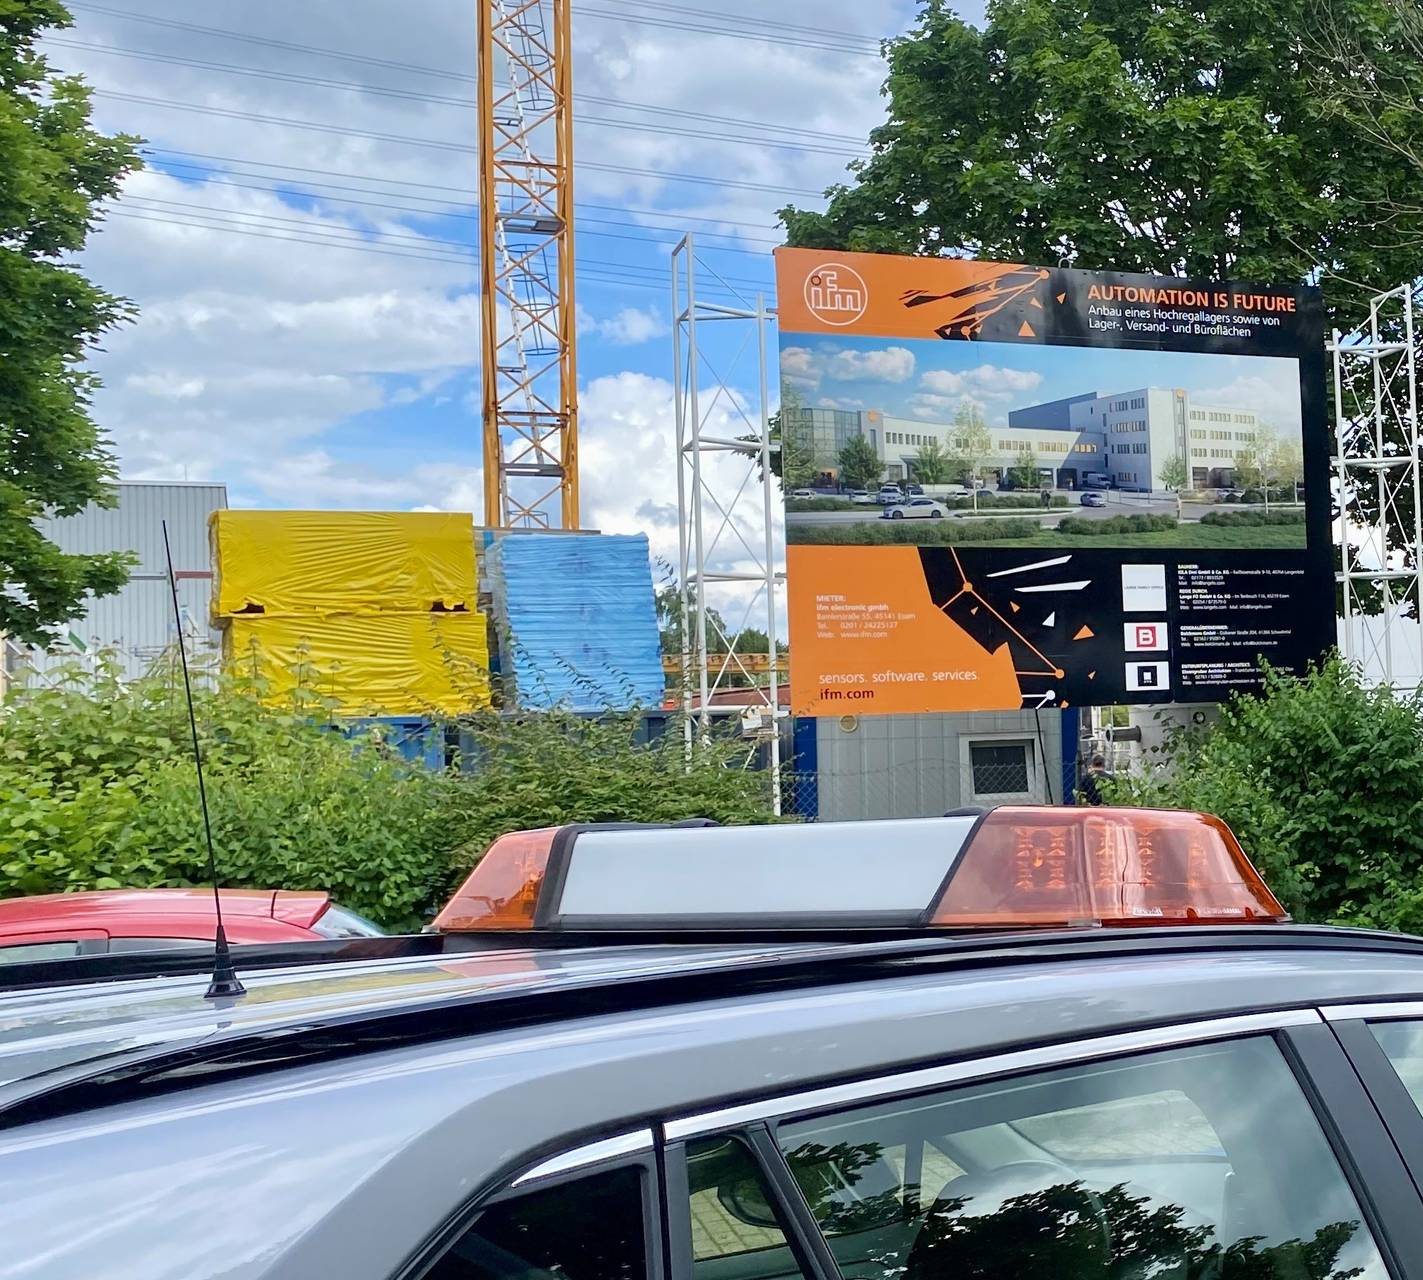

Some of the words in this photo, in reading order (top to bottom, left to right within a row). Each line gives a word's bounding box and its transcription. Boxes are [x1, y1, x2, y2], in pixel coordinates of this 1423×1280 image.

[811, 271, 861, 311] ifm
[1088, 285, 1208, 306] AUTOMATION
[1214, 293, 1228, 308] IS
[1234, 294, 1296, 312] FUTURE
[1088, 305, 1122, 317] Anbau
[1125, 307, 1150, 318] eines
[1153, 310, 1230, 324] Hochregallagers
[1232, 314, 1260, 324] sowie
[1262, 318, 1280, 326] von
[1089, 318, 1124, 332] Lager-,
[1126, 320, 1170, 332] Versand-
[1172, 323, 1192, 334] und
[1194, 323, 1251, 337] Büroflächen
[867, 604, 889, 612] gmbh
[1139, 629, 1154, 645] B
[819, 672, 868, 684] sensors.
[872, 670, 928, 682] software.
[932, 669, 980, 681] services.
[820, 688, 874, 700] ifm.com
